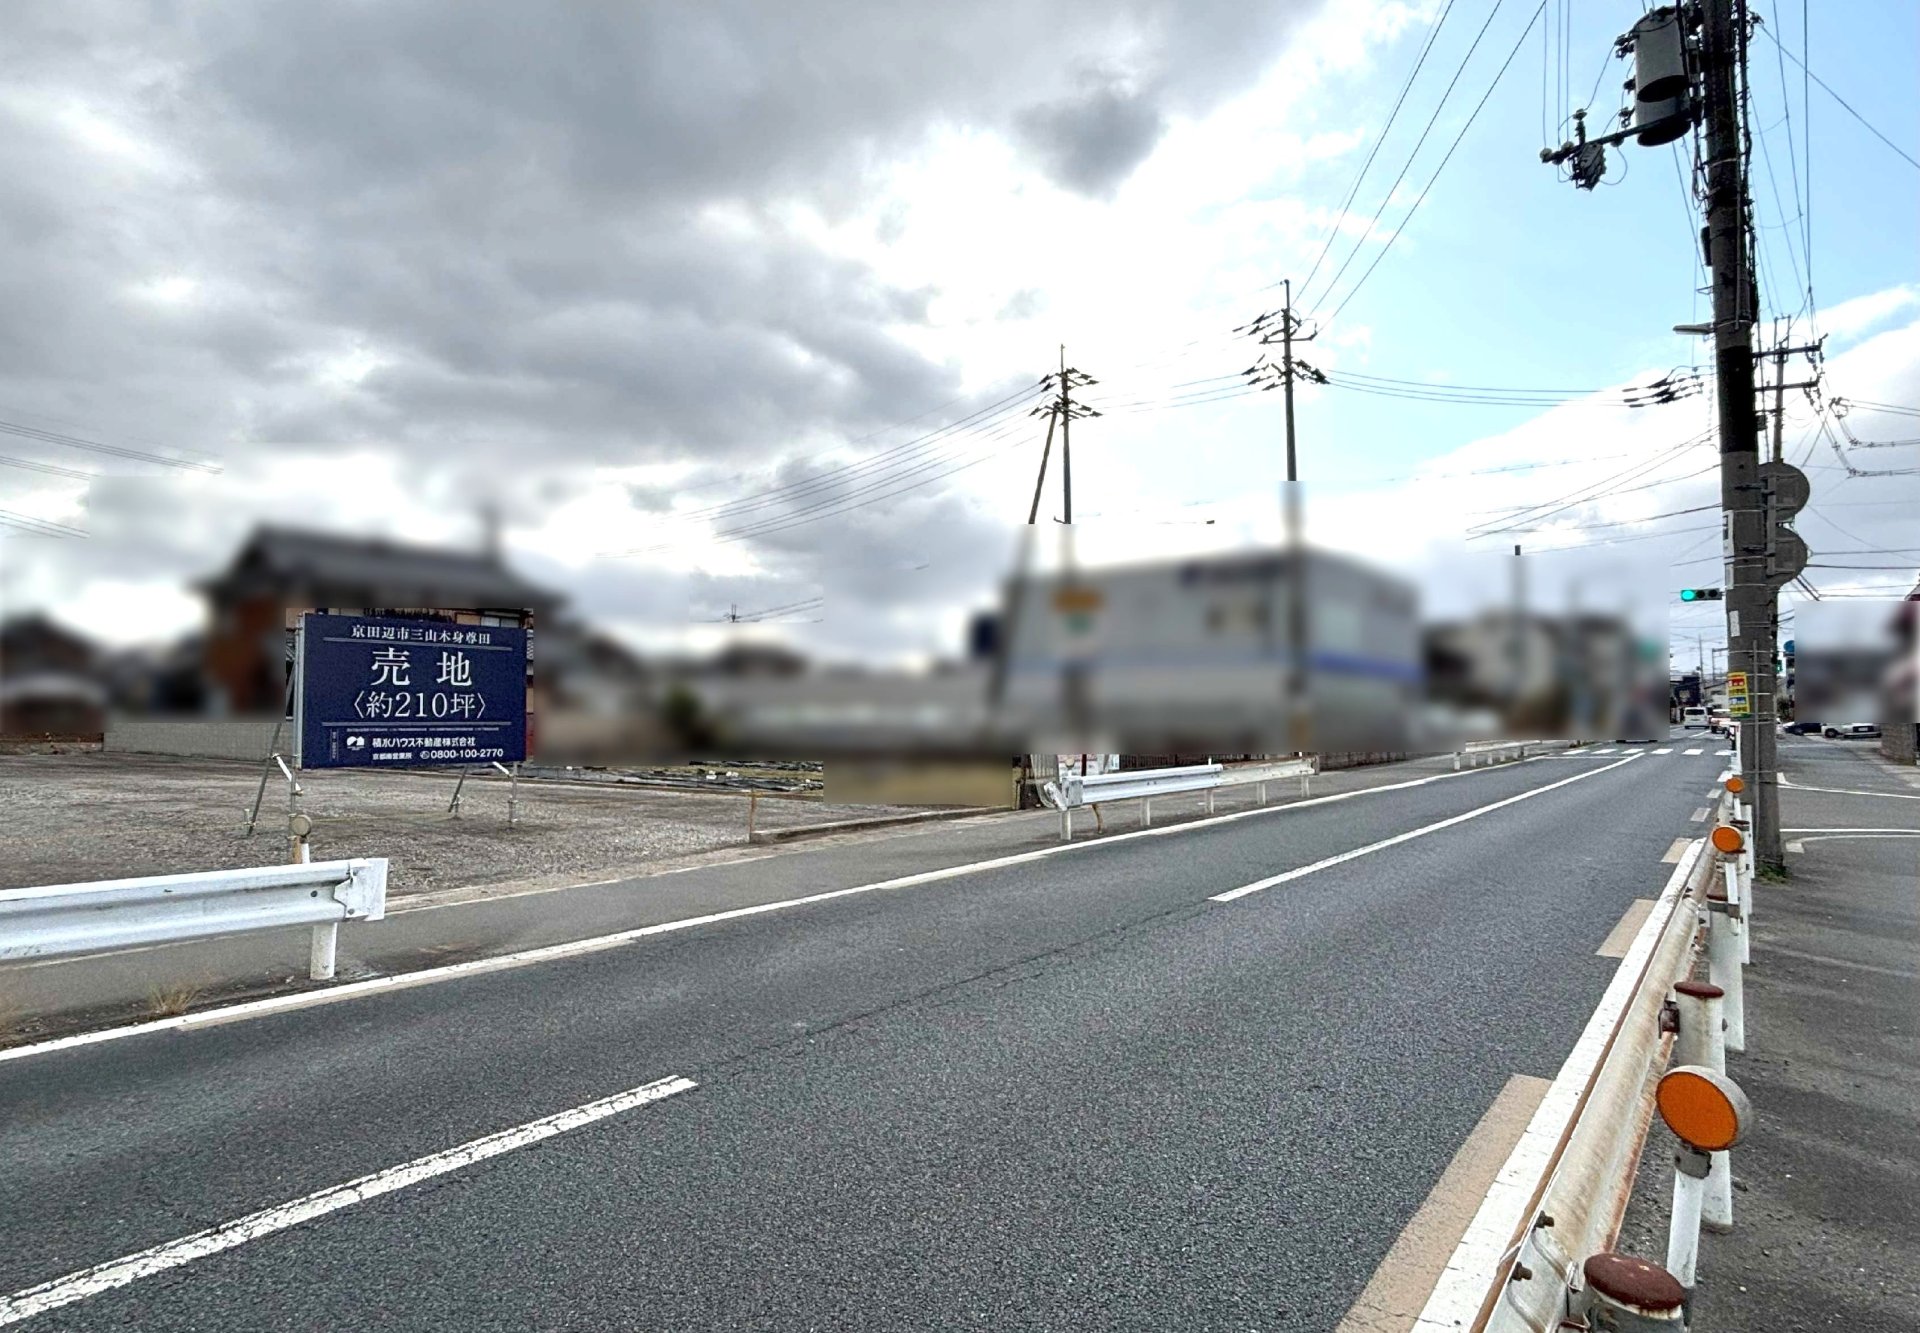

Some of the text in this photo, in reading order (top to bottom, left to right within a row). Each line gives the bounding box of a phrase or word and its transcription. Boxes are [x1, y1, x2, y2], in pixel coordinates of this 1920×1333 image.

[351, 624, 491, 645] 京田辺市三山木身尊田
[372, 737, 476, 749] 積水ハウス不動産株式会社
[430, 748, 504, 759] 0800-100-2770
